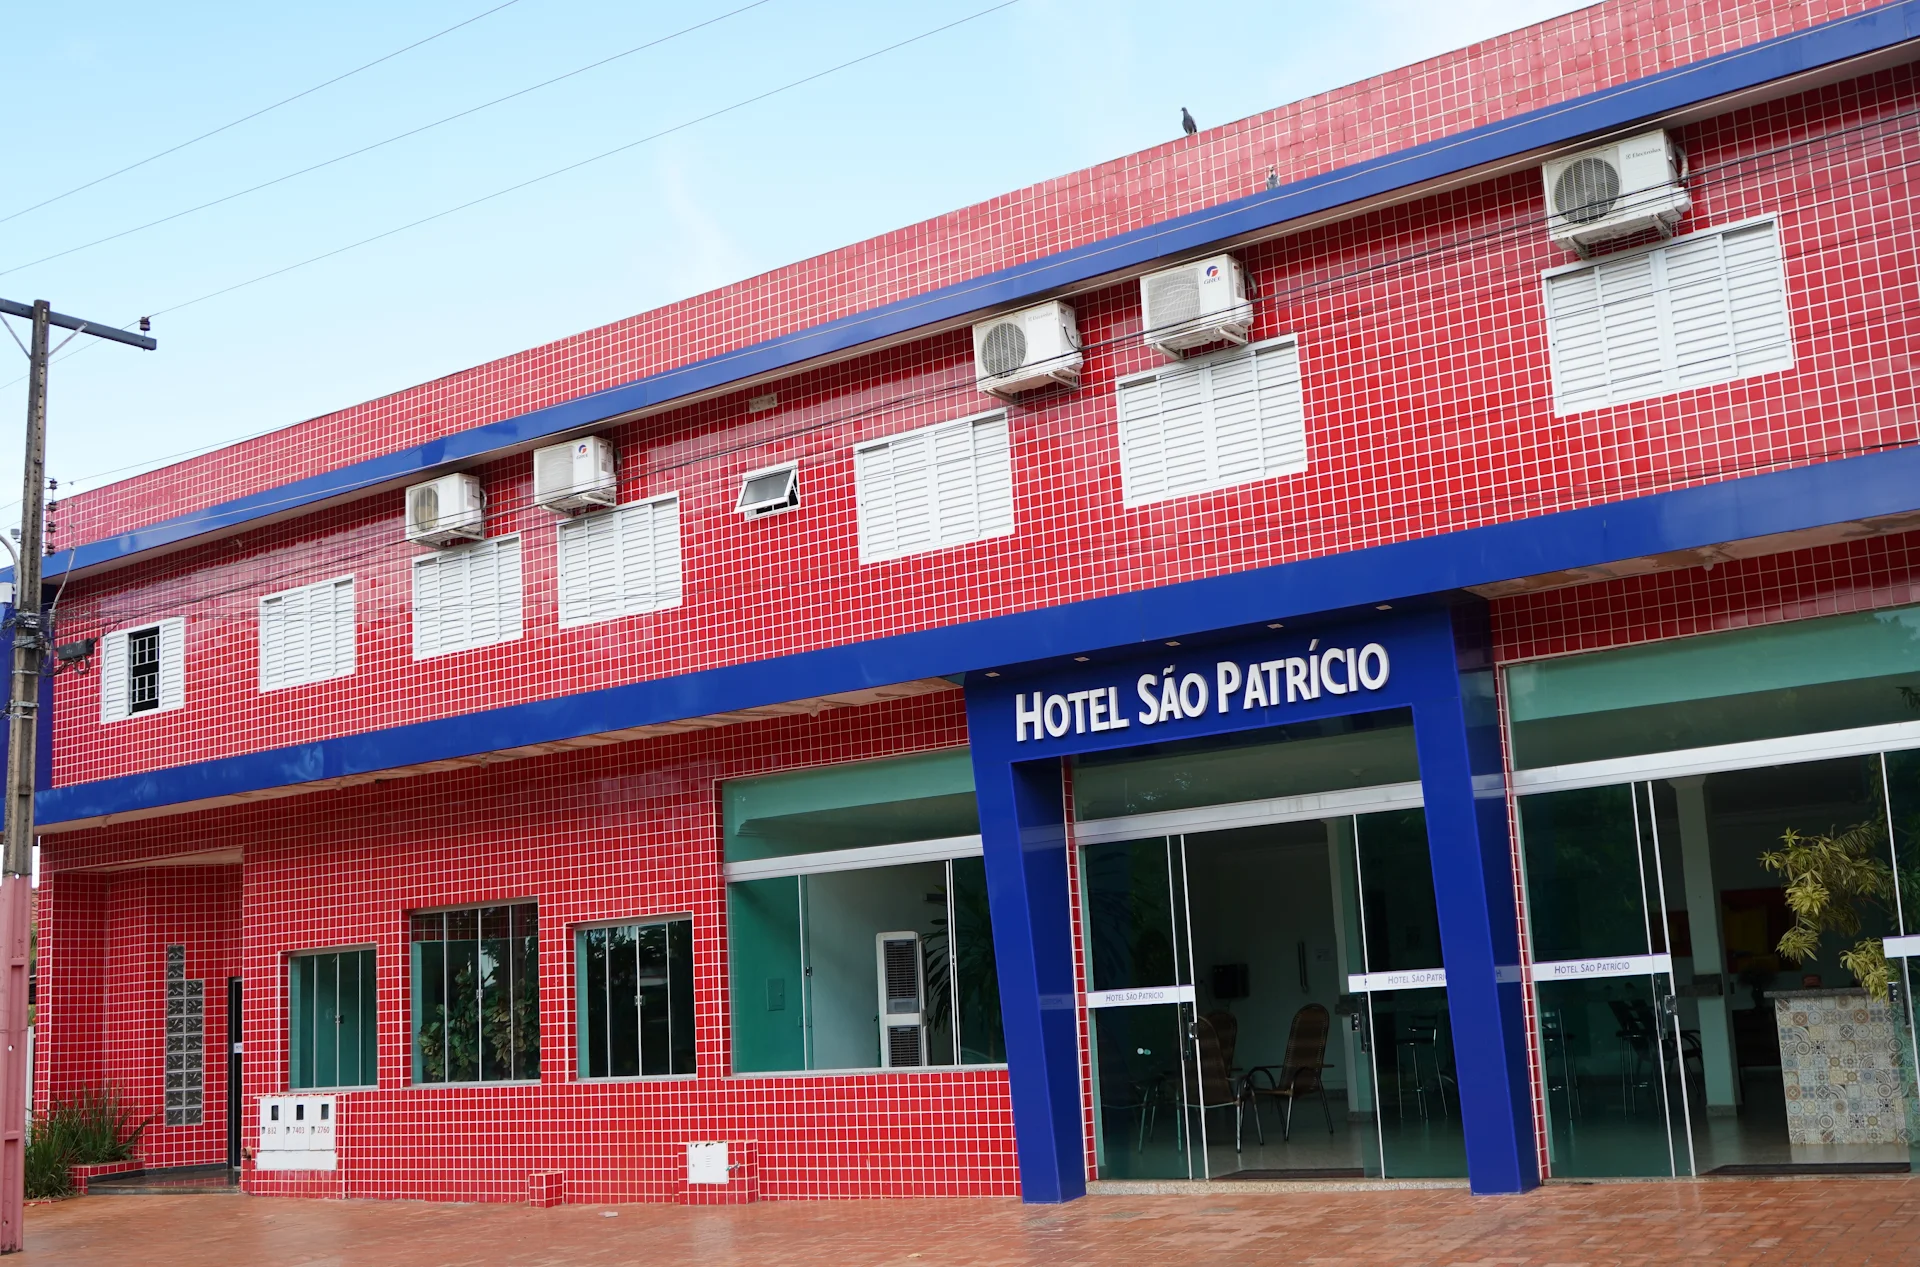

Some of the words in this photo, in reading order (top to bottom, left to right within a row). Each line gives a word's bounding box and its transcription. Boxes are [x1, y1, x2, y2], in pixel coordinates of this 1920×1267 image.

[1015, 686, 1131, 742] HOTEL
[1136, 664, 1209, 726] SÃO
[1216, 638, 1390, 714] PATRÍCIO
[1554, 964, 1578, 975] HOTEL
[1580, 963, 1596, 973] SÃO
[1596, 961, 1631, 972] PATRÍCIO
[1387, 976, 1410, 985] HOTEL
[1411, 974, 1426, 984] SÃO
[1105, 993, 1125, 1002] HOTEL
[1126, 991, 1138, 1001] SÃO
[1138, 991, 1164, 1000] PATRÍCIO
